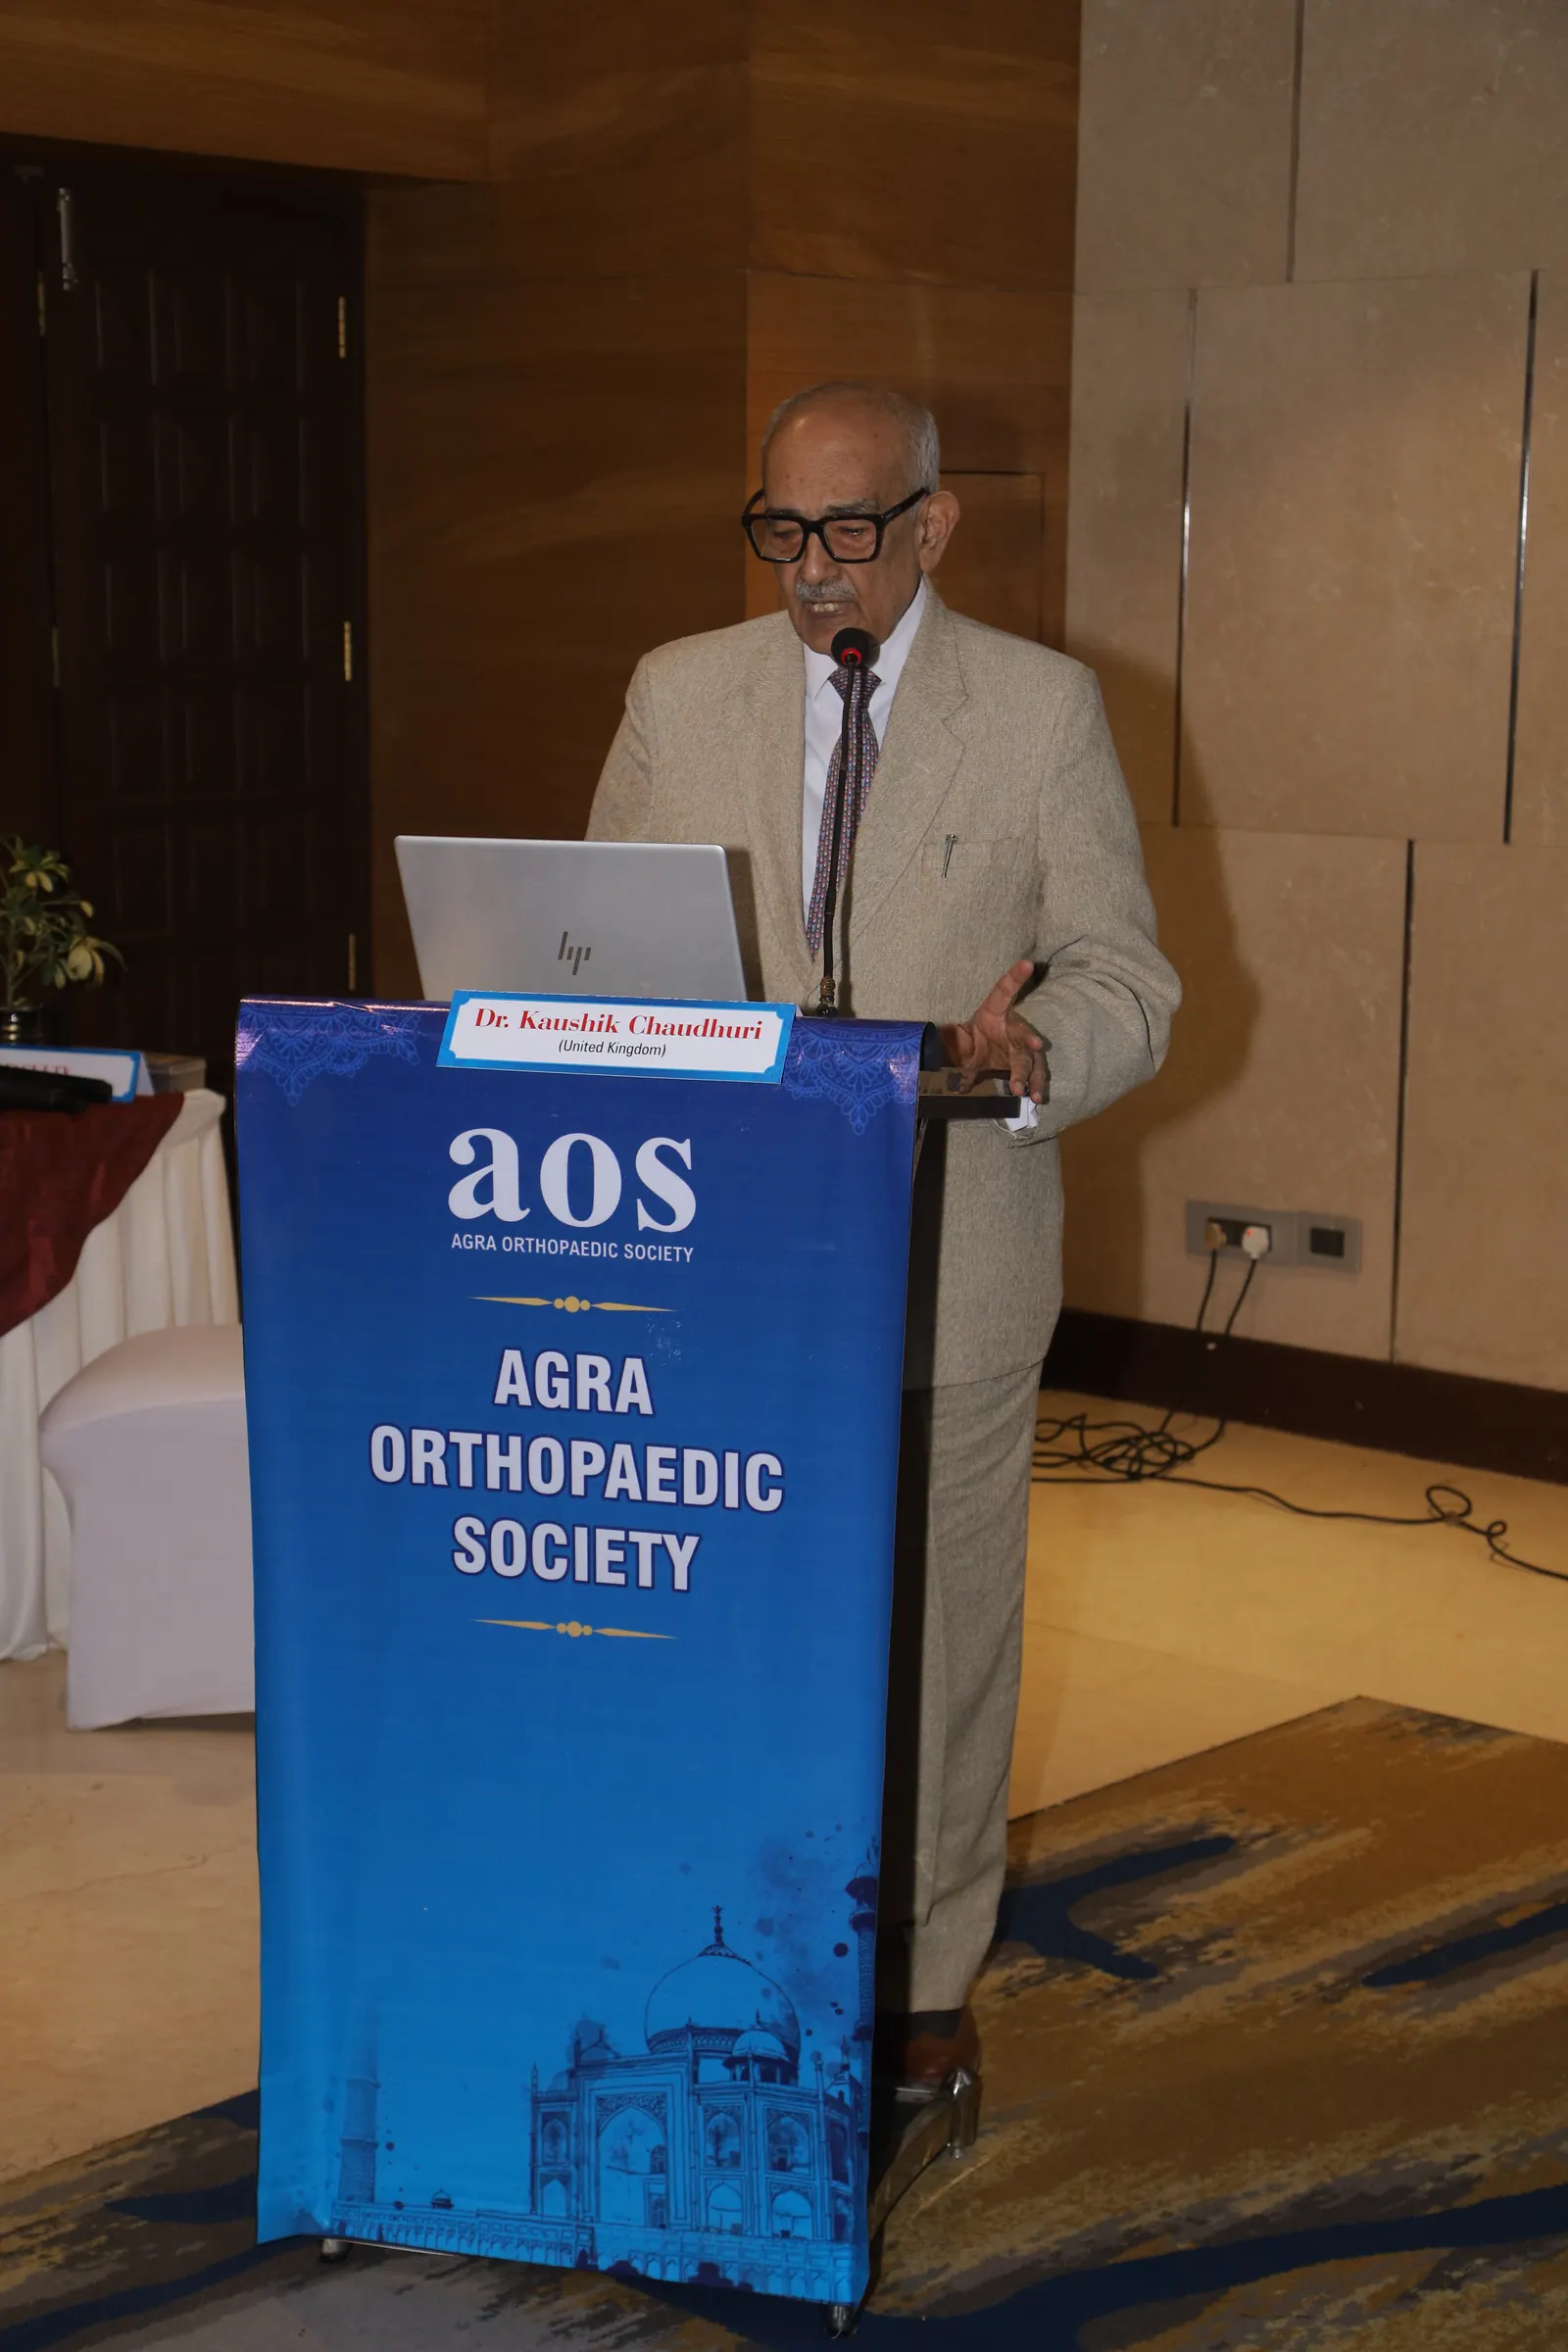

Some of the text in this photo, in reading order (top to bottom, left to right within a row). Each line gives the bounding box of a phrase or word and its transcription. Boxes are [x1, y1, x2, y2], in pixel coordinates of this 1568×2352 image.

[558, 931, 592, 976] hp
[474, 1007, 763, 1040] Dr. Kaushik Chaudhuri
[558, 1039, 667, 1057] (United Kingdom)
[448, 1127, 697, 1234] aos
[451, 1232, 695, 1263] AGRA ORTHOPAEDIC SOCIETY
[493, 1348, 654, 1415] AGRA
[369, 1424, 783, 1512] ORTHOPAEDIC
[453, 1515, 701, 1592] SOCIETY
